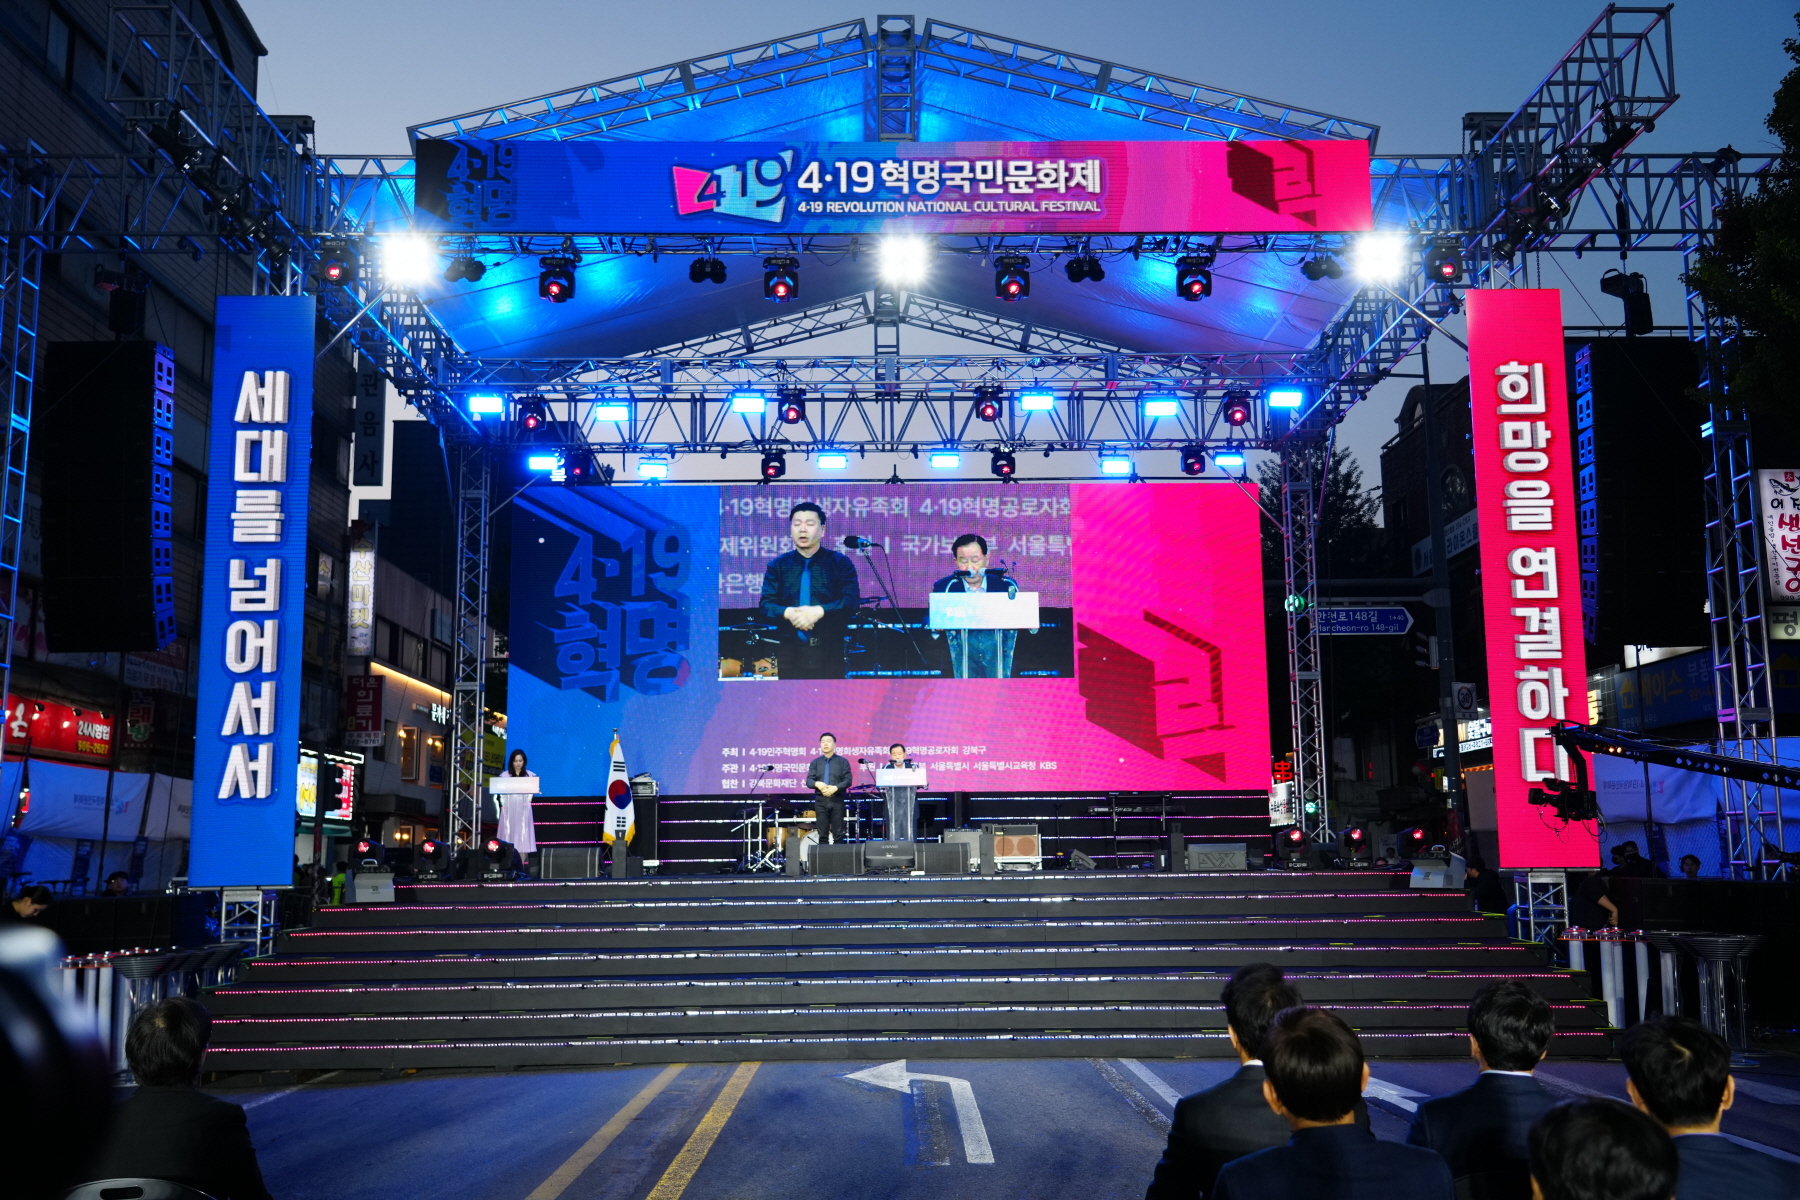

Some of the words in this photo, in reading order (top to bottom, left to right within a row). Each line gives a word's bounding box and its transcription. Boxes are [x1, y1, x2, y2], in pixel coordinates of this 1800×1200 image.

[797, 161, 874, 194] 4·19
[879, 159, 1101, 194] 혁명국민문화제
[827, 201, 906, 213] REVOLUTION
[907, 201, 971, 212] NATIONAL
[973, 201, 1039, 212] CULTURAL
[1041, 201, 1101, 212] FESTIVAL
[356, 370, 381, 478] 관음사
[231, 370, 290, 543] 세대를
[1494, 360, 1555, 531] 희망을
[718, 496, 909, 518] ·19혁명생자유족회
[1008, 534, 1072, 557] 서울특
[350, 537, 374, 629] 수산마켓
[1318, 610, 1378, 623] 한천로148길
[1371, 623, 1399, 633] 148-gil
[217, 557, 282, 800] 넘어서서
[1507, 546, 1570, 783] 연결하다
[127, 690, 155, 742] 노래방
[356, 690, 374, 731] 의료기
[77, 720, 111, 741] 24시영업
[721, 747, 739, 757] 주최
[749, 746, 807, 757] 4·19민주혁명회
[810, 745, 891, 757] 4·1명희생자유족회
[962, 745, 987, 756] 강북구
[721, 763, 739, 774] 주관
[930, 761, 970, 771] 서울특별시
[973, 760, 1036, 771] 서울특별시교육청
[1039, 761, 1057, 770] KBS
[721, 778, 739, 789] 협찬
[749, 778, 797, 789] 강북문화재단
